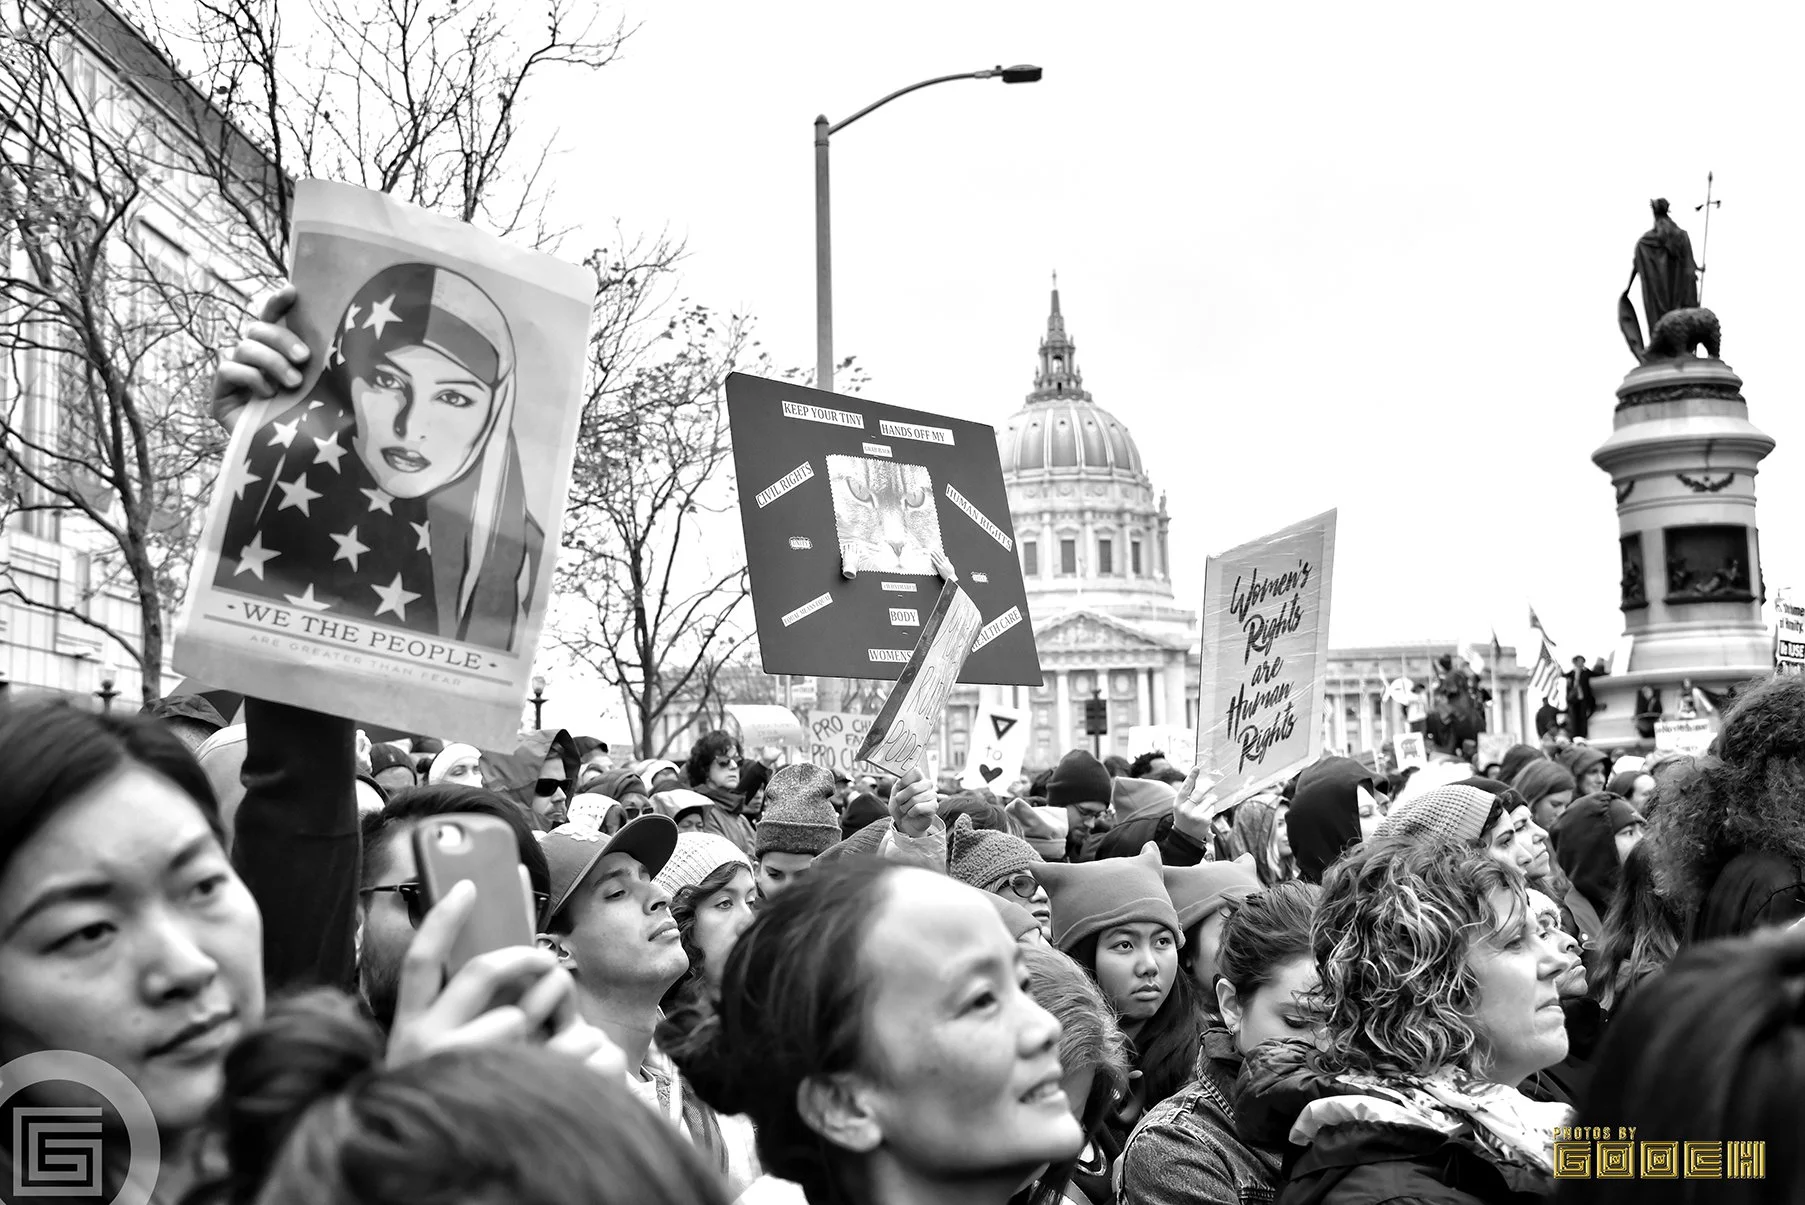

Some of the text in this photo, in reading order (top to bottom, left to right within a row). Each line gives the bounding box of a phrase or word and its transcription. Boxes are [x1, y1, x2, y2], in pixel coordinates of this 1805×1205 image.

[783, 402, 862, 426] KEEP YOUR TINY
[881, 423, 945, 442] HANDS OFF MY
[756, 463, 812, 506] CIVIL RIGHTS
[946, 486, 1011, 549] HUMAN RIGHTS
[1230, 559, 1312, 624] Women's
[243, 602, 482, 671] WE THE PEOPLE
[890, 611, 917, 623] BODY
[1000, 609, 1020, 629] CARE
[1243, 592, 1304, 665] Rights
[250, 634, 462, 687] ARE GREATER THAN FEAR
[1251, 656, 1284, 687] are
[811, 715, 844, 742] PRO
[1226, 682, 1294, 741] Human
[811, 743, 836, 769] PRO
[1238, 702, 1298, 775] Rights
